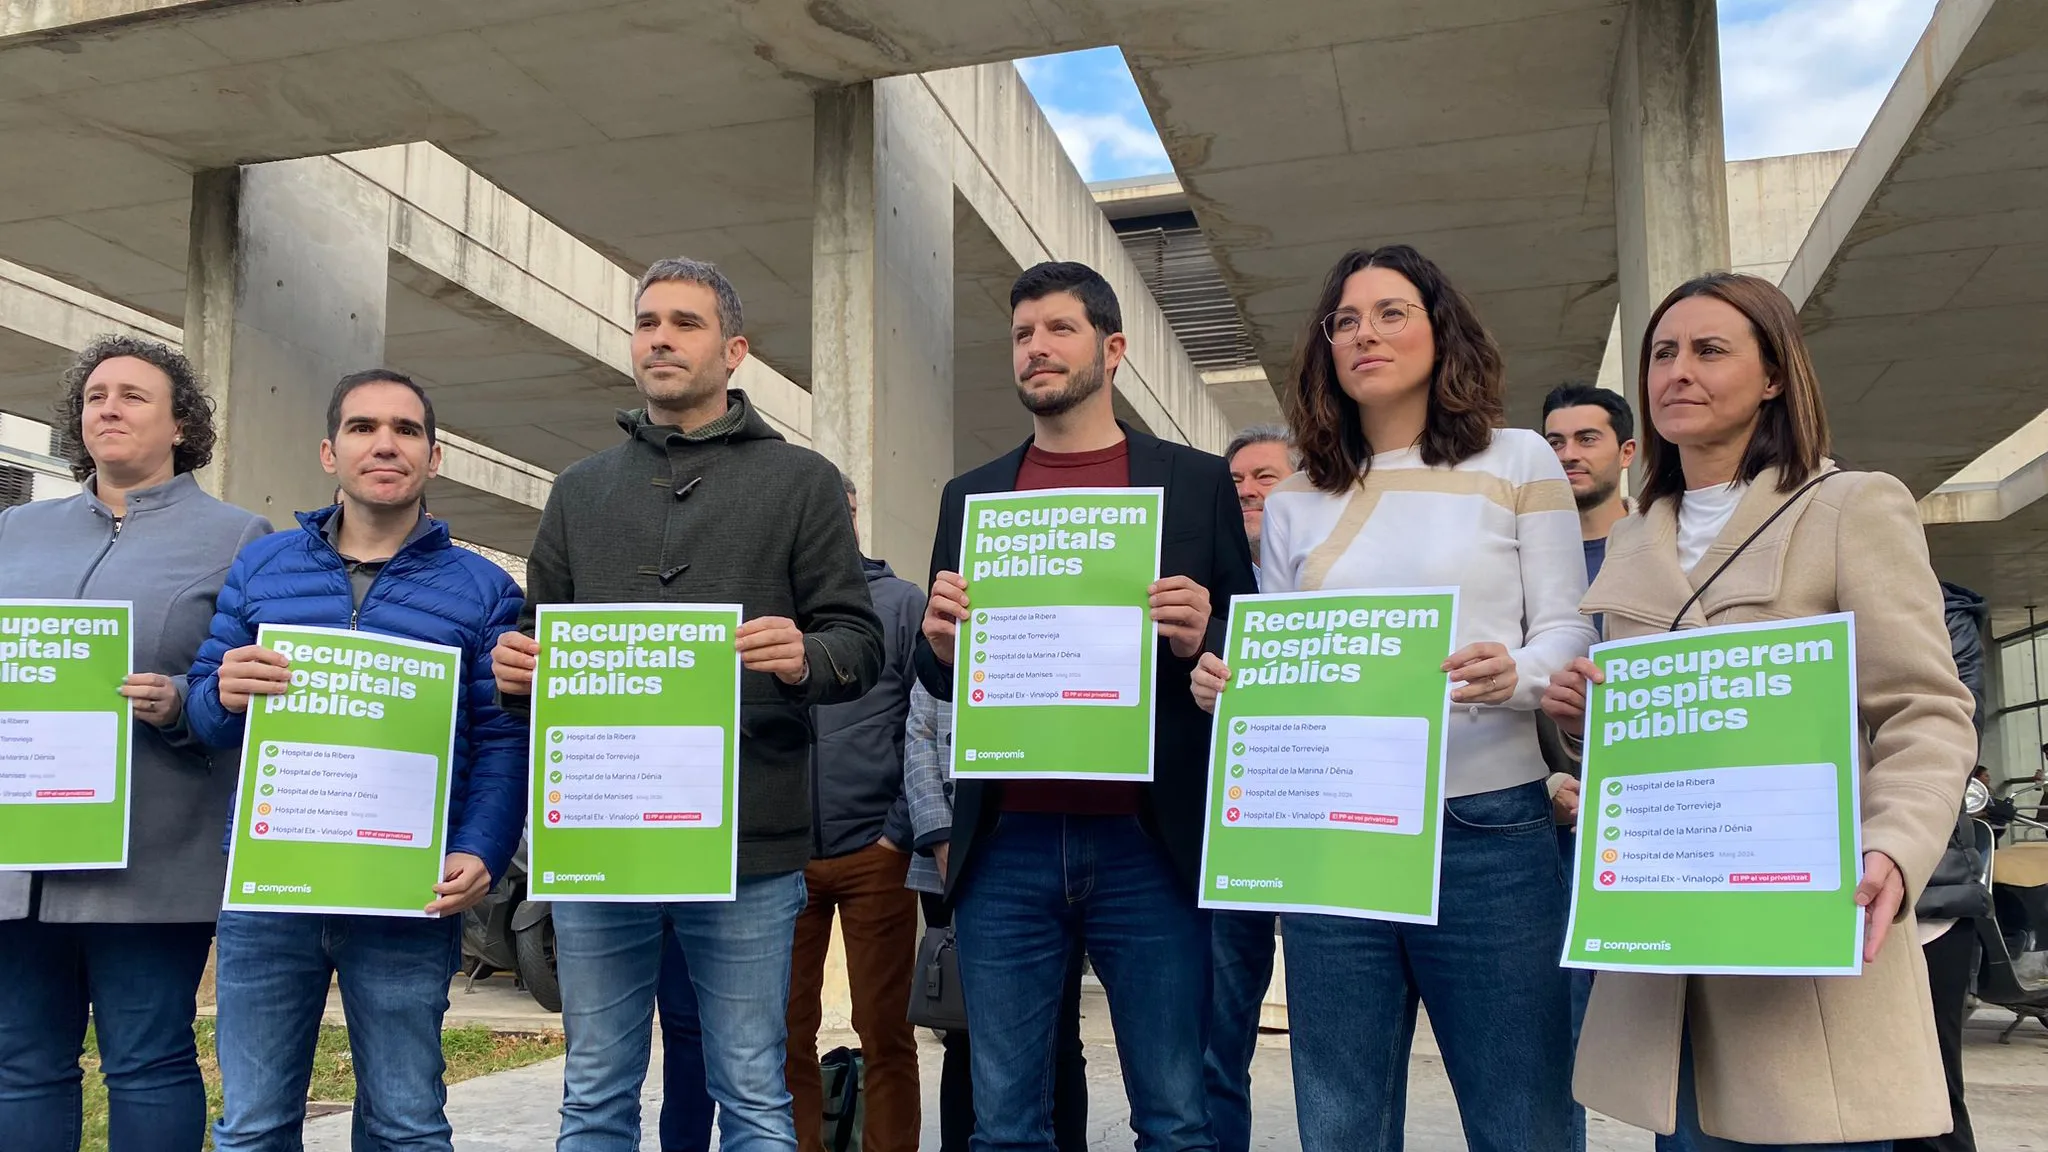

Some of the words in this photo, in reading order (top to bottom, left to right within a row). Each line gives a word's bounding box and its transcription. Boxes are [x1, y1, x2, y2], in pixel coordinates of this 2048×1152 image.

[978, 506, 1146, 528] Recuperem
[976, 529, 1116, 553] hospitals
[973, 554, 1082, 581] públics
[1244, 608, 1439, 632] Recuperem
[551, 621, 726, 644] Recuperem
[1240, 633, 1402, 660] hospitals
[273, 640, 446, 680] Recuperem
[550, 646, 695, 671] hospitals
[1605, 639, 1833, 683] Recuperem
[1236, 660, 1361, 689] públics
[290, 669, 416, 700] ospitals
[548, 670, 662, 698] públics
[988, 692, 1014, 700] Hospital
[1605, 672, 1792, 713] hospitals
[265, 689, 384, 719] públics
[1250, 724, 1281, 732] Hospital
[1604, 708, 1748, 746] públics
[282, 749, 312, 757] Hospital
[978, 750, 1024, 760] compromís
[1249, 745, 1279, 754] Hospital
[280, 768, 310, 776] Hospital
[322, 771, 358, 779] Torrevieja
[1248, 767, 1277, 776] Hospital
[278, 787, 308, 796] Hospital
[1626, 781, 1662, 793] Hospital
[1686, 778, 1715, 786] Ribera
[1246, 789, 1277, 798] Hospital
[275, 807, 306, 815] Hospital
[1626, 805, 1662, 816] Hospital
[1677, 801, 1721, 811] Torrevieja
[564, 813, 593, 821] Hospital
[1244, 812, 1275, 820] Hospital
[1292, 812, 1325, 820] Vinalopó
[273, 826, 304, 835] Hospital
[321, 828, 353, 837] Vinalopó
[1624, 828, 1661, 838] Hospital
[1686, 825, 1717, 834] Marina
[1725, 824, 1752, 833] Dénia
[1623, 851, 1661, 861] Hospital
[1662, 851, 1674, 859] de
[1676, 850, 1714, 858] Manises
[556, 872, 605, 883] compromís
[1230, 877, 1283, 889] compromís
[1621, 874, 1660, 884] Hospital
[1661, 874, 1675, 882] Elx
[1682, 874, 1724, 884] Vinalopó
[258, 884, 311, 894] compromís
[1604, 940, 1671, 952] compromís
